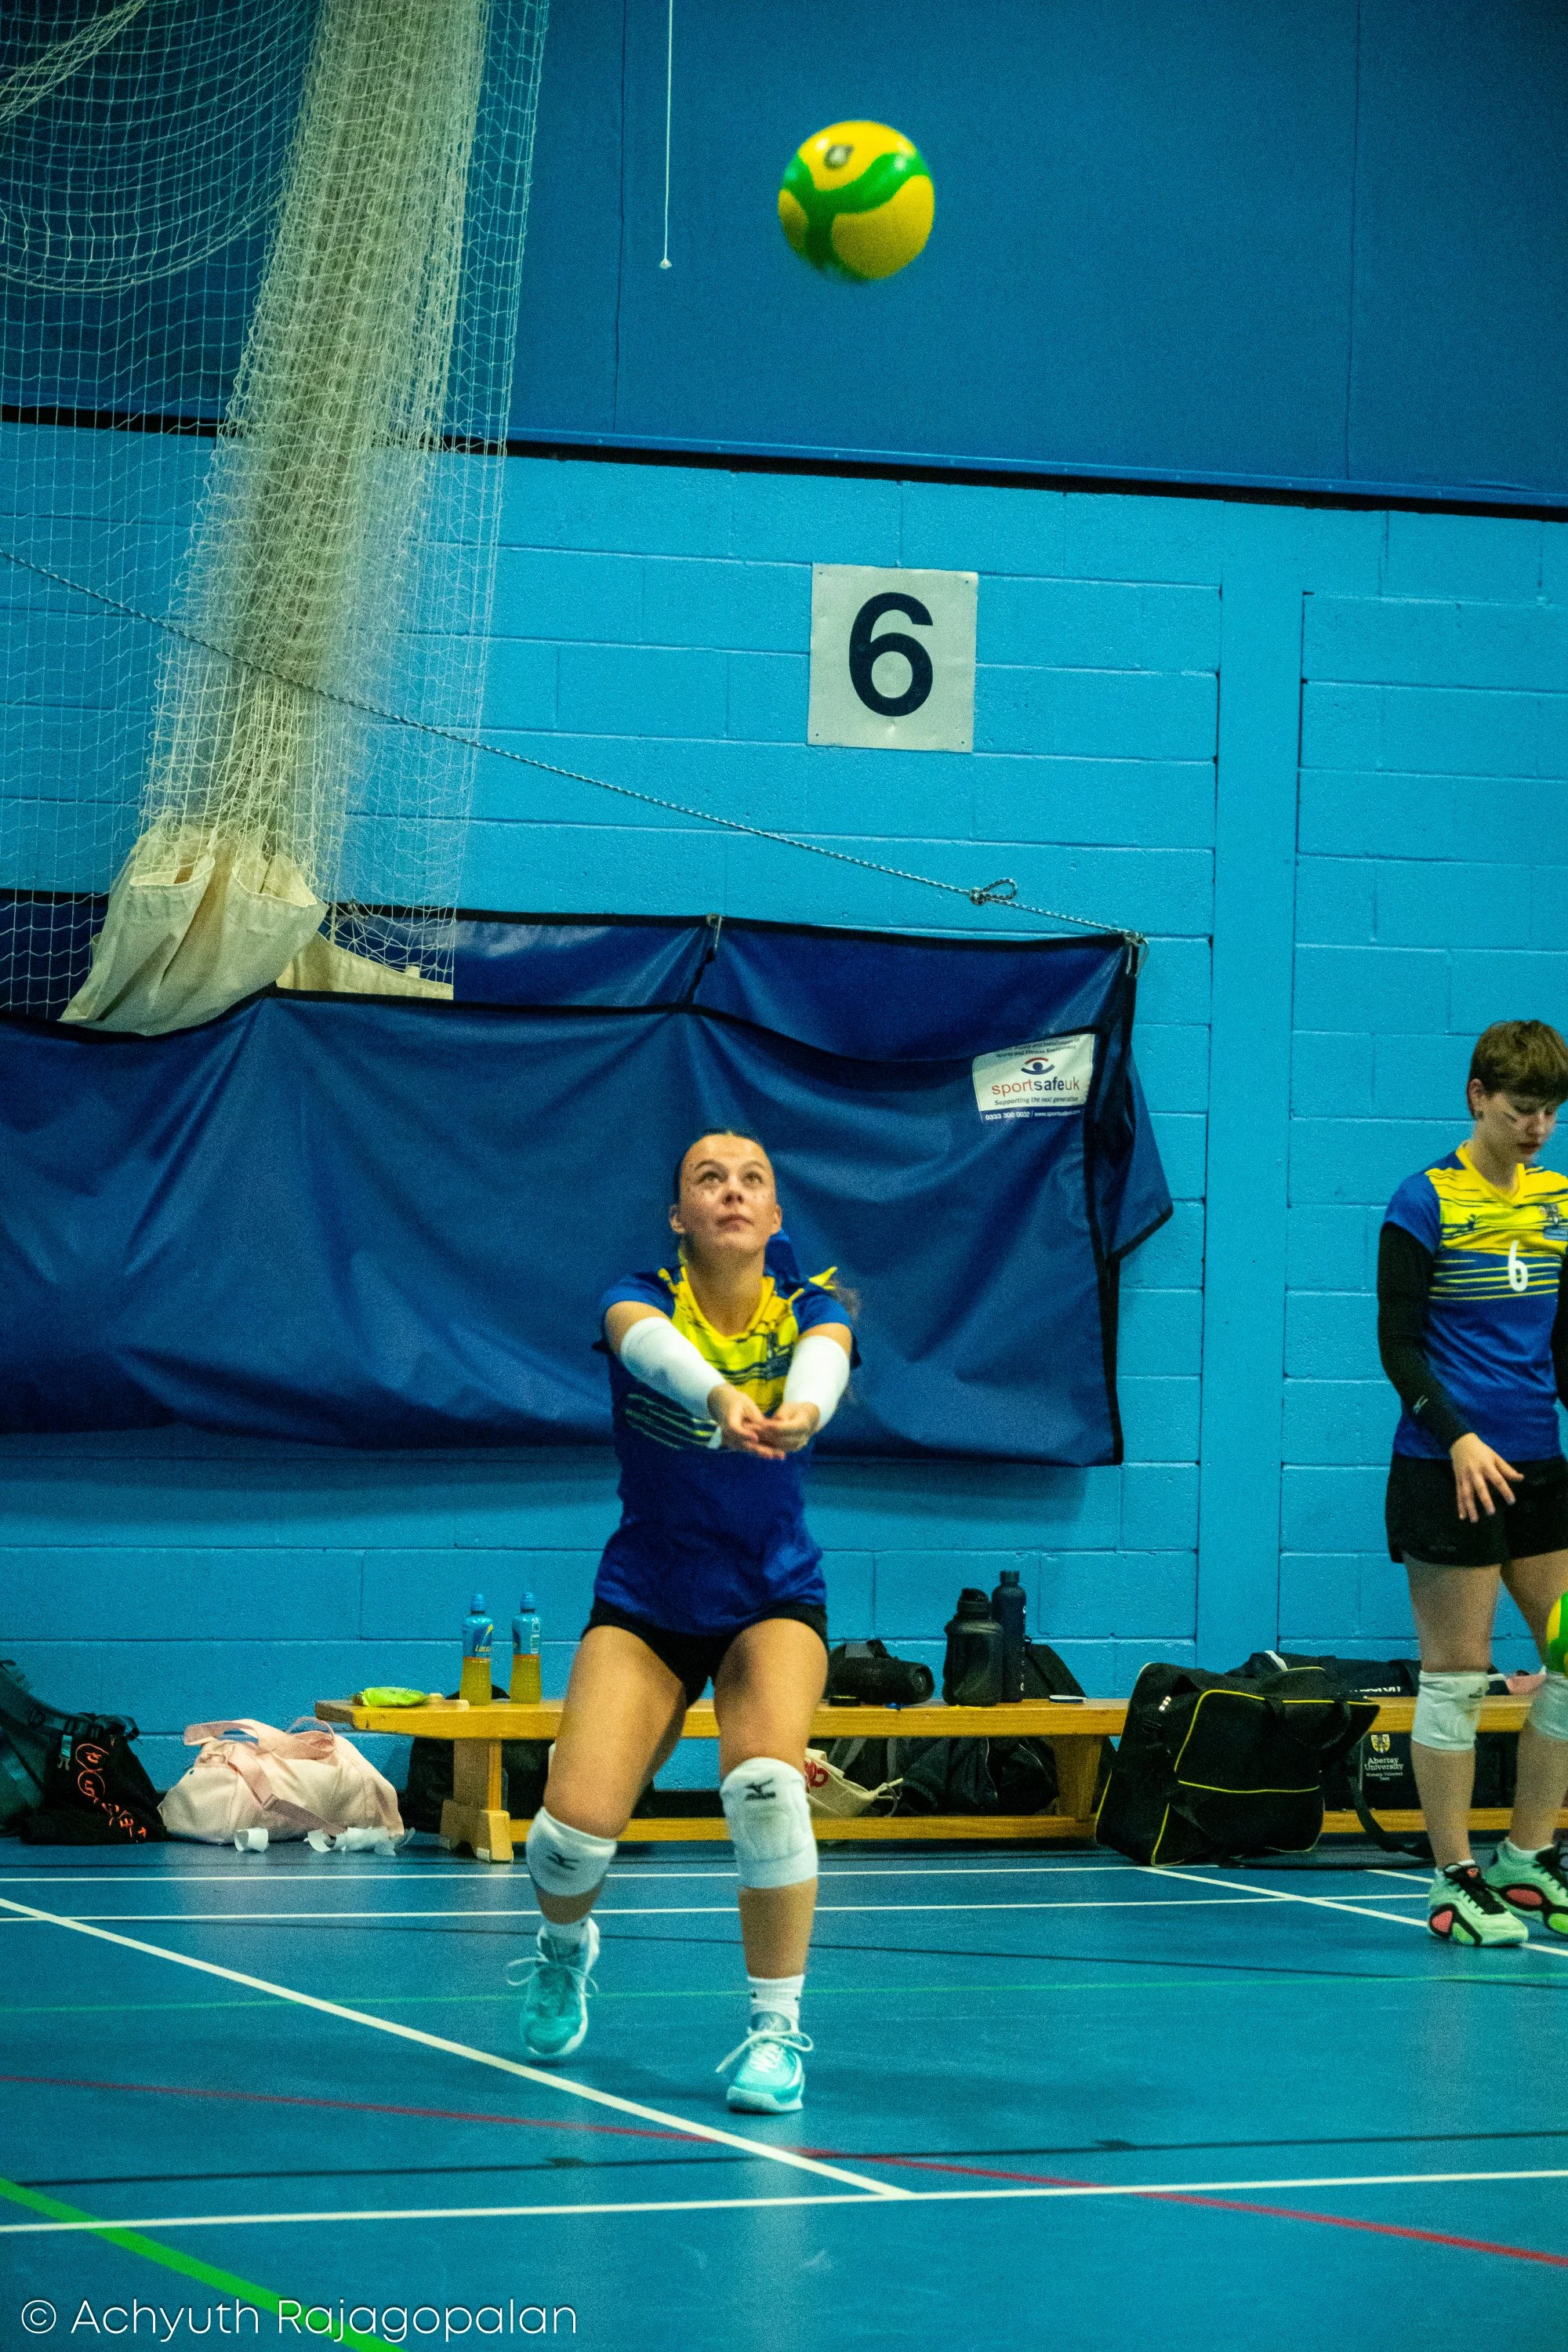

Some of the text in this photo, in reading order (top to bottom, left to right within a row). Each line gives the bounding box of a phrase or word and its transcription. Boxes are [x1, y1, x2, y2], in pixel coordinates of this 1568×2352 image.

[849, 592, 933, 717] 6
[992, 1076, 1080, 1097] sportsafeuk
[994, 1097, 1029, 1106] Supporting
[1508, 1240, 1529, 1292] 6
